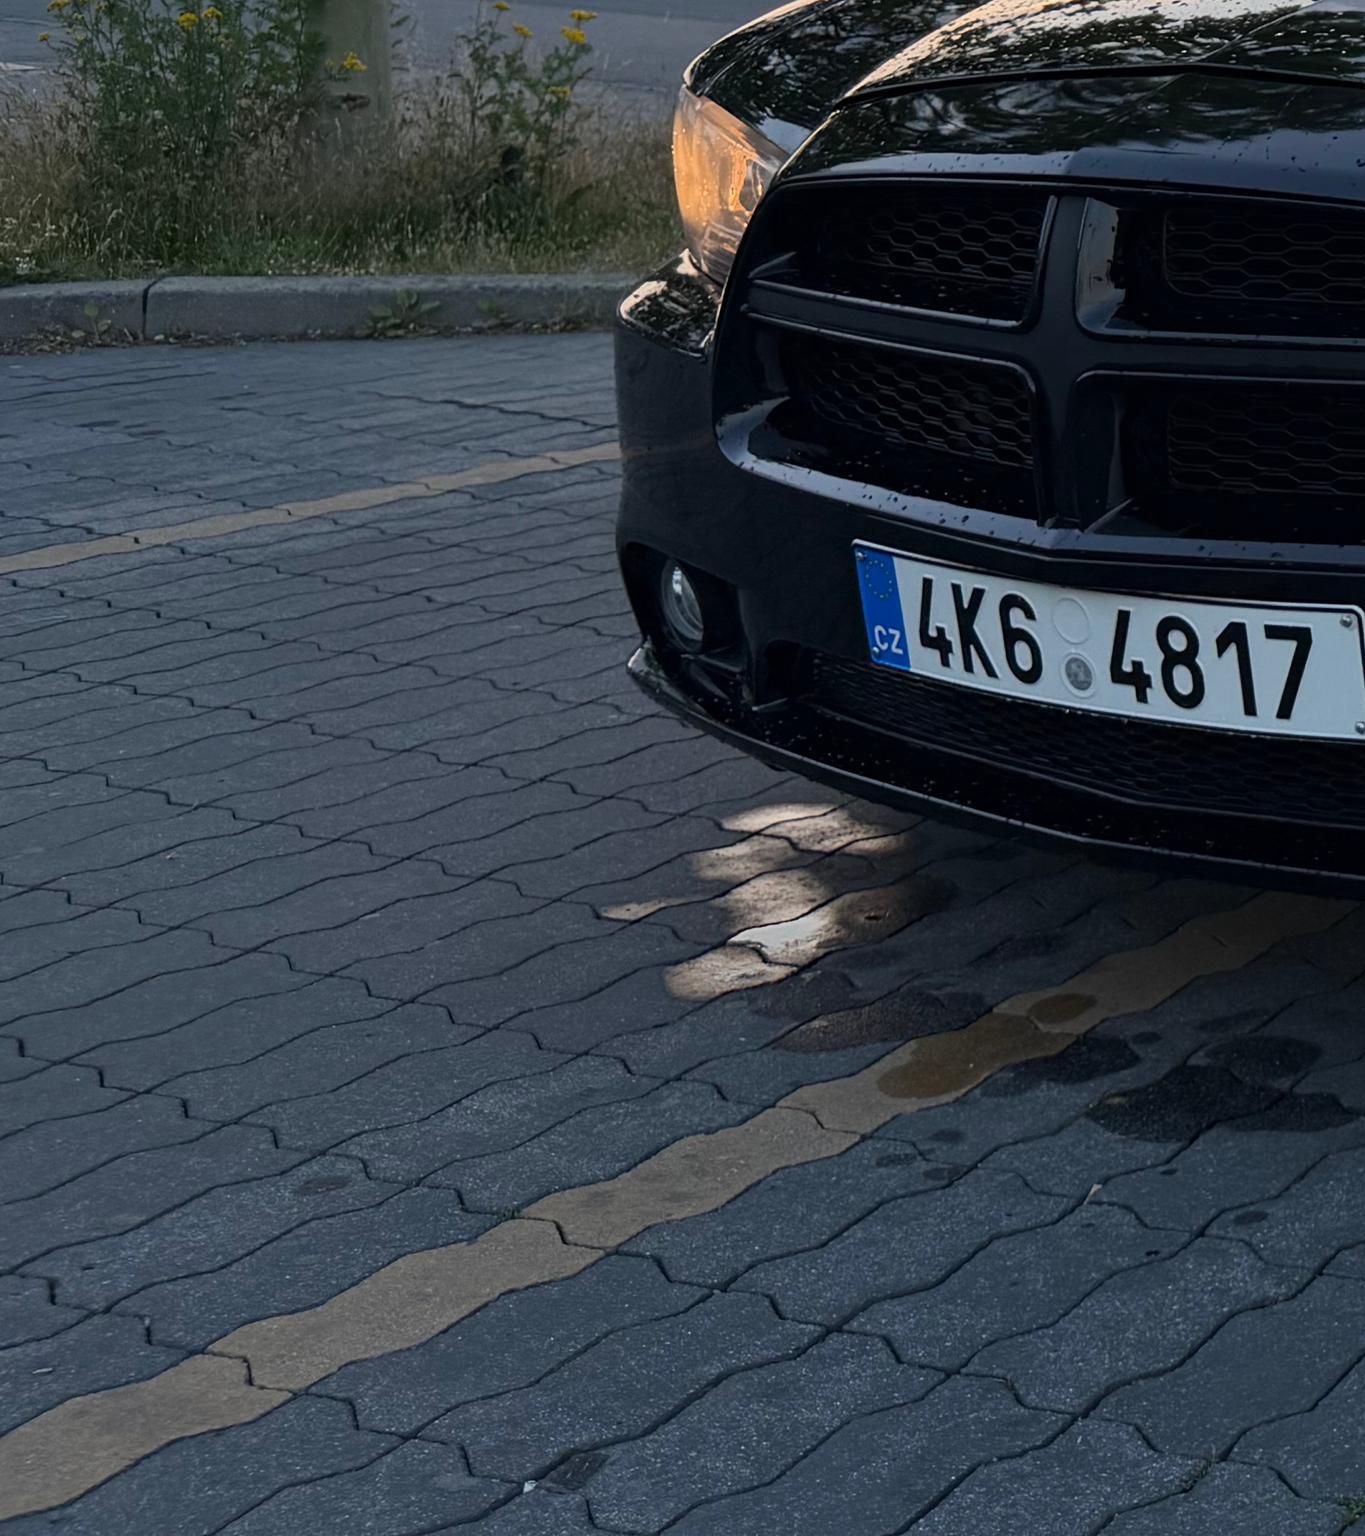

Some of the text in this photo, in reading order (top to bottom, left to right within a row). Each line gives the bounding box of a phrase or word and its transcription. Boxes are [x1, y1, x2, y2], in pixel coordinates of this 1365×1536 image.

[874, 625, 903, 654] CZ
[919, 576, 1313, 720] 4K6 4817
